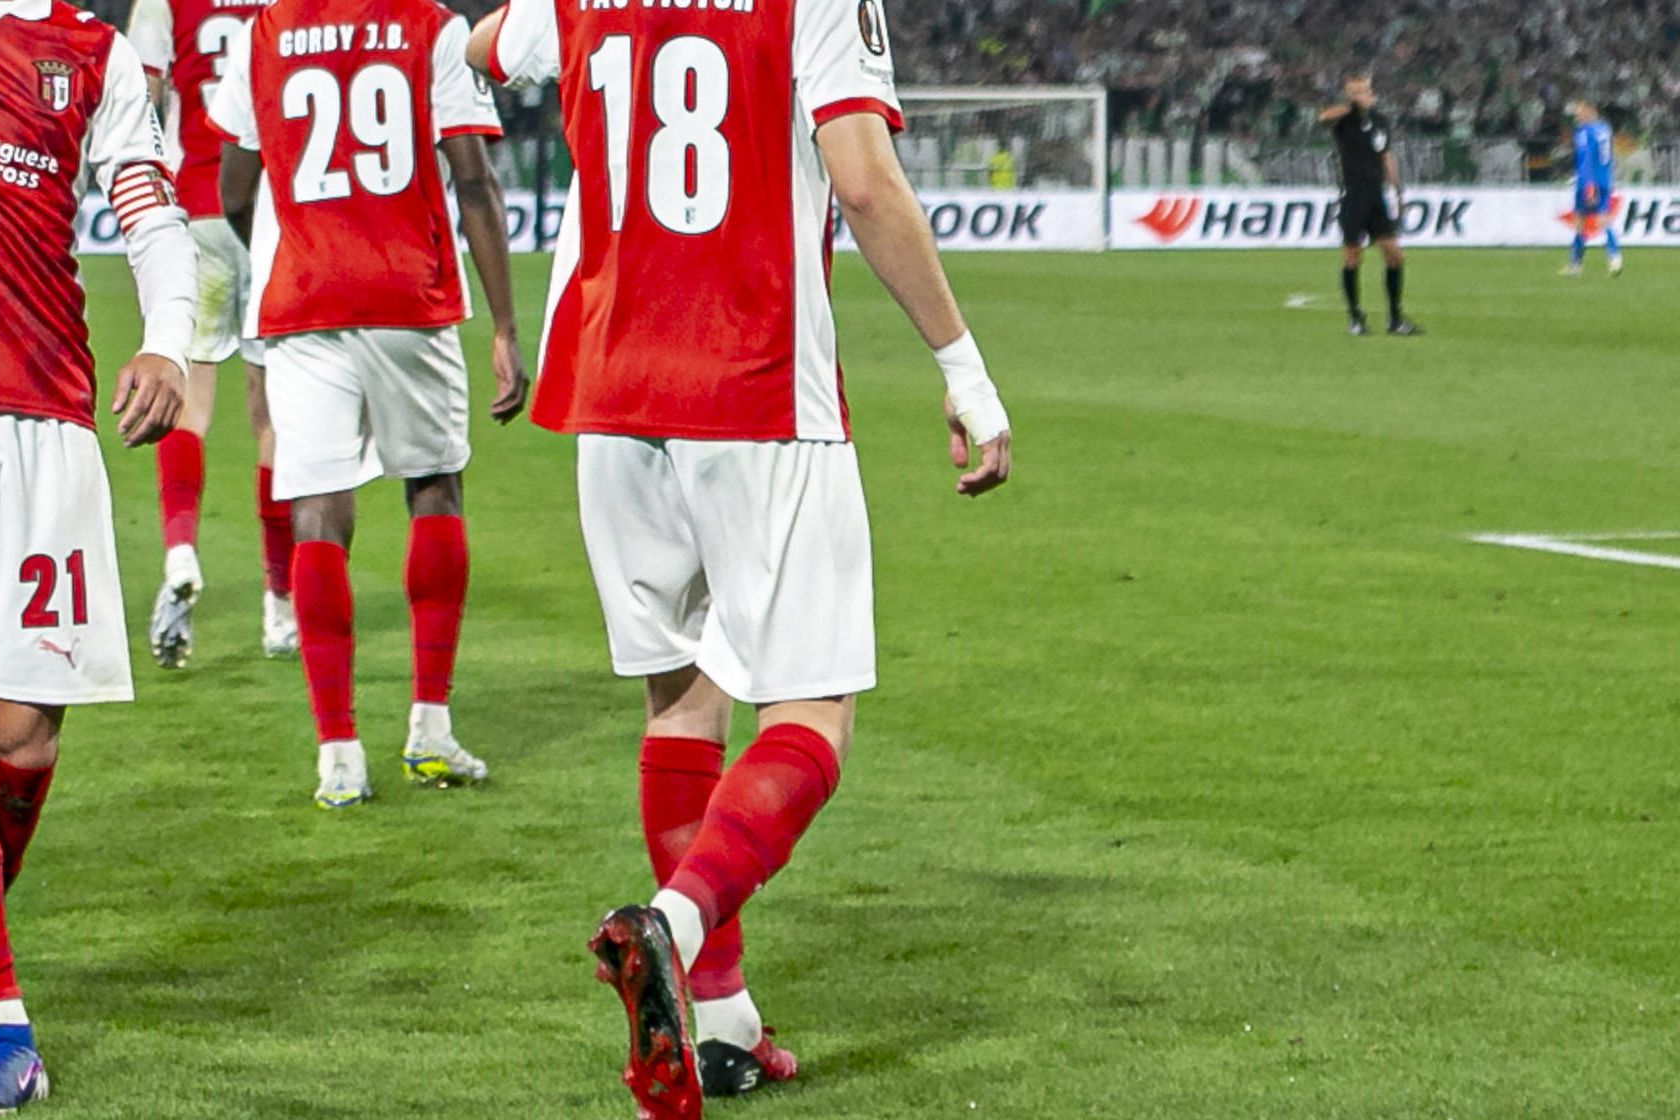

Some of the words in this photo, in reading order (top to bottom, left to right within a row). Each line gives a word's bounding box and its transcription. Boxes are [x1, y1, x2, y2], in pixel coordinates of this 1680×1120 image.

[279, 24, 354, 57] GORBY
[364, 23, 409, 50] J.B.
[280, 64, 416, 204] 29
[588, 33, 731, 235] 18
[19, 548, 88, 628] 21
